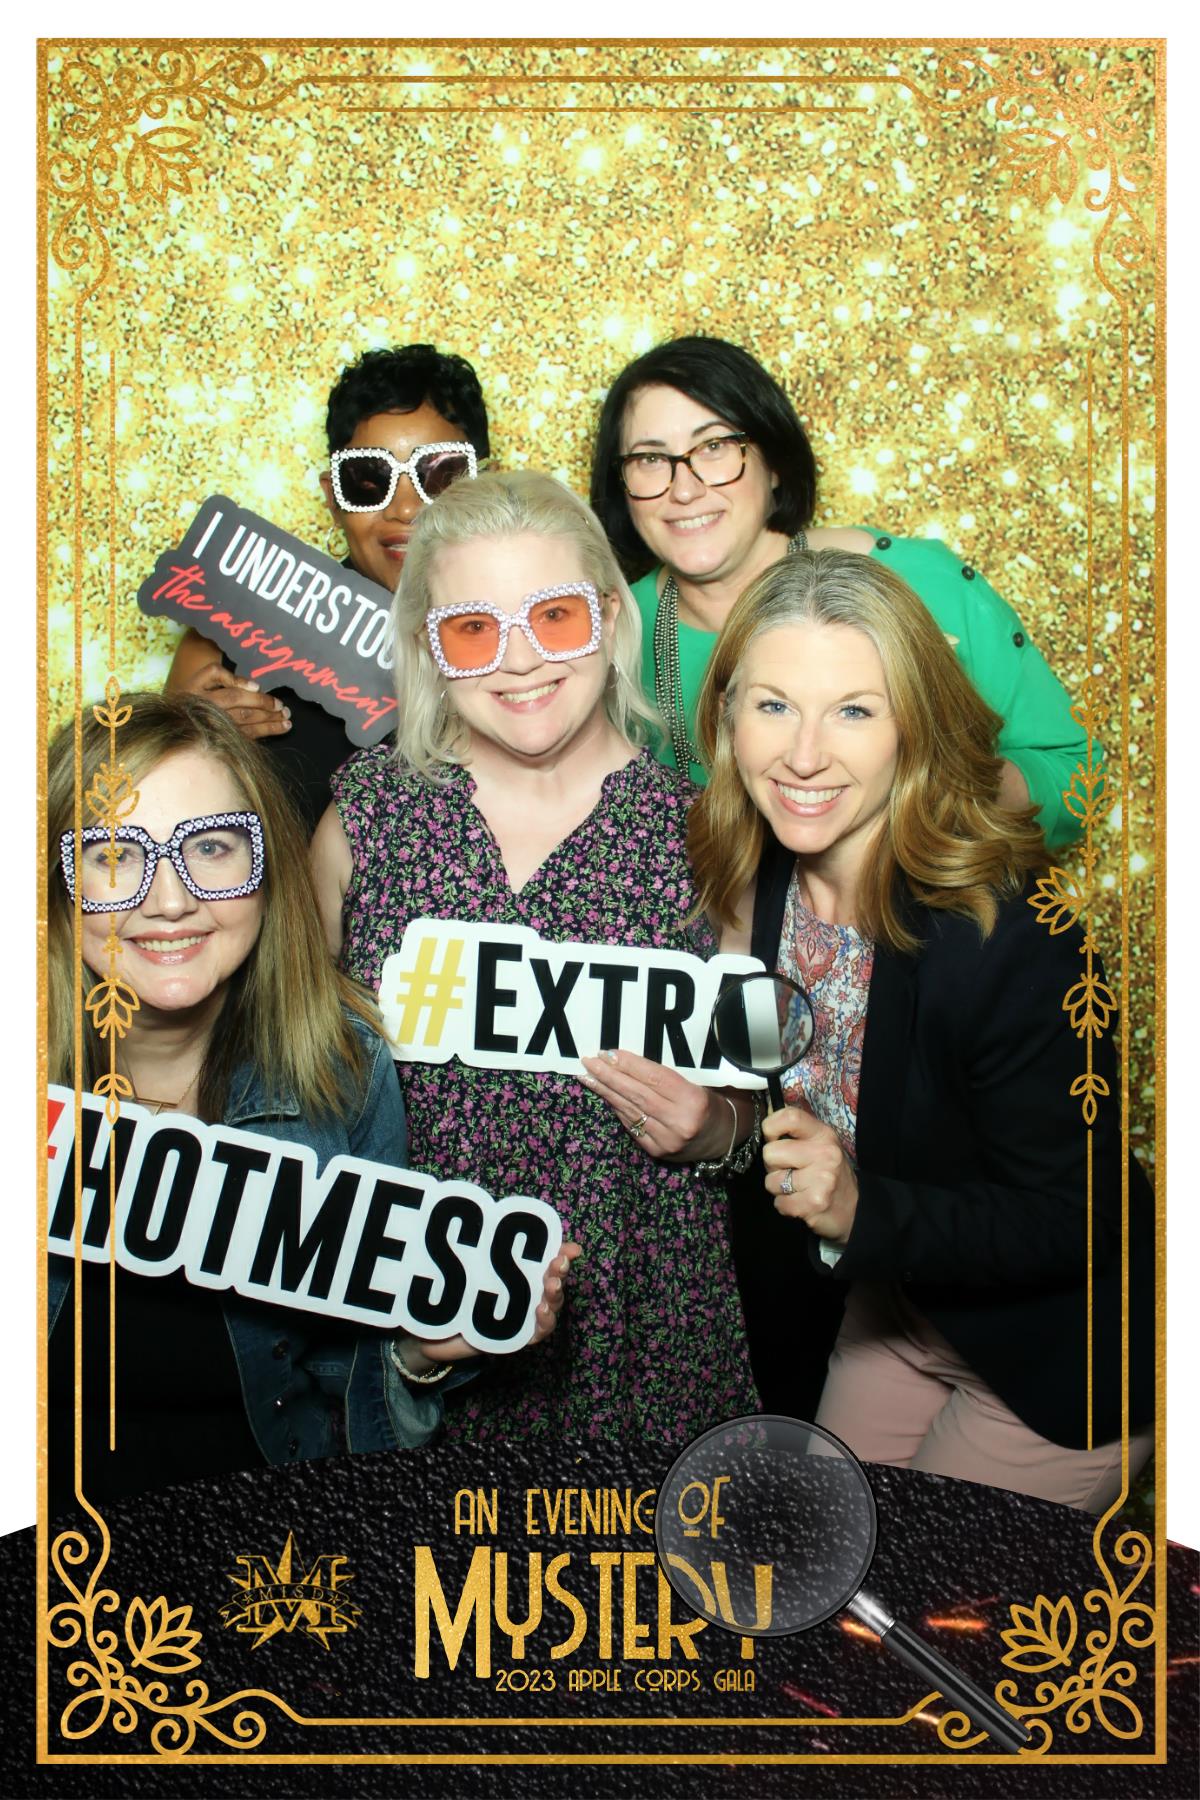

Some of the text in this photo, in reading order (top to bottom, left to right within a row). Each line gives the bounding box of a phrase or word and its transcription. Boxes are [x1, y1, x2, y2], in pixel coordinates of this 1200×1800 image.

[192, 511, 223, 559] I
[152, 564, 398, 731] the assignment
[48, 1099, 549, 1341] HOTMESS
